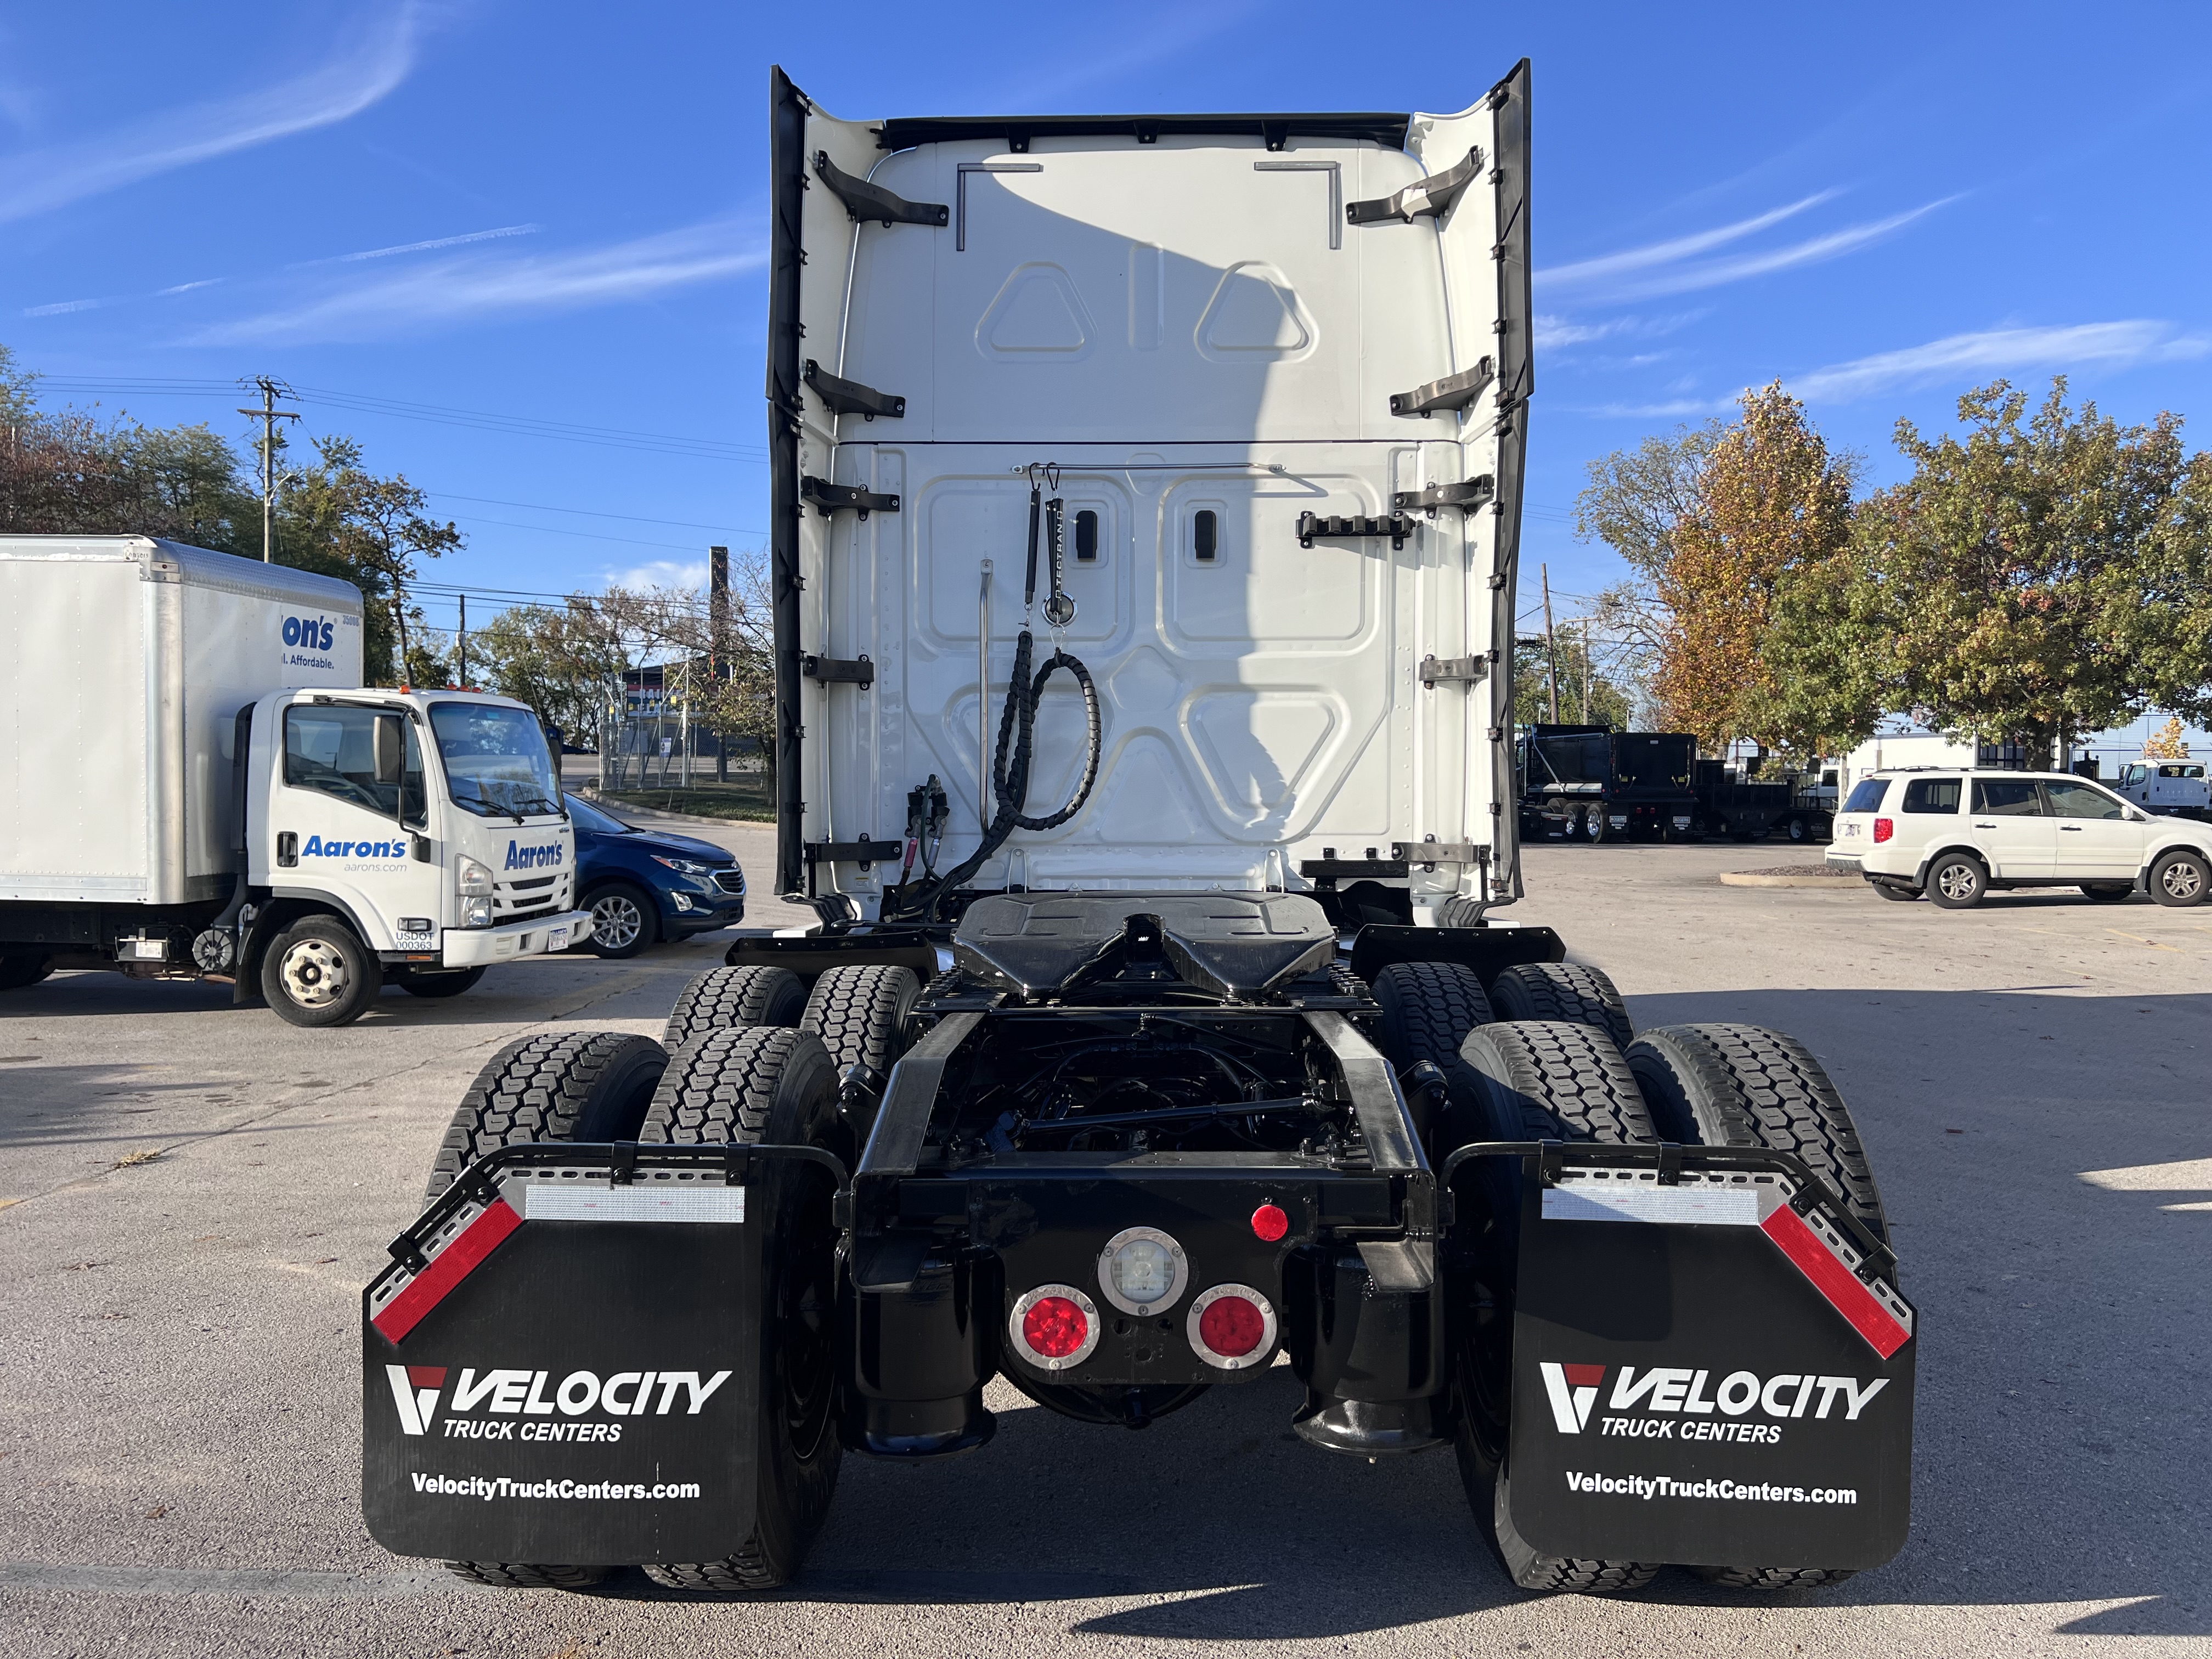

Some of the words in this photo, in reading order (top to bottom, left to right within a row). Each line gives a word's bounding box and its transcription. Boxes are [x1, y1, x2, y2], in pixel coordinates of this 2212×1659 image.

[281, 615, 334, 651] on's
[342, 614, 359, 627] 35008
[290, 654, 334, 669] Affordable.
[301, 835, 406, 858] Aaron's
[504, 840, 563, 871] Aaron's
[344, 864, 407, 873] aarons.com
[396, 932, 434, 940] USDOT
[396, 941, 432, 950] 000363
[451, 1368, 733, 1416] VELOCITY
[1609, 1365, 1891, 1420] VELOCITY
[443, 1419, 516, 1441] TRUCK
[520, 1421, 622, 1442] CENTERS
[1600, 1417, 1676, 1439] TRUCK
[1680, 1420, 1782, 1444] CENTERS
[411, 1472, 701, 1501] VelocityTruckCenters.com
[1566, 1471, 1857, 1504] VelocityTruckCenters.com
